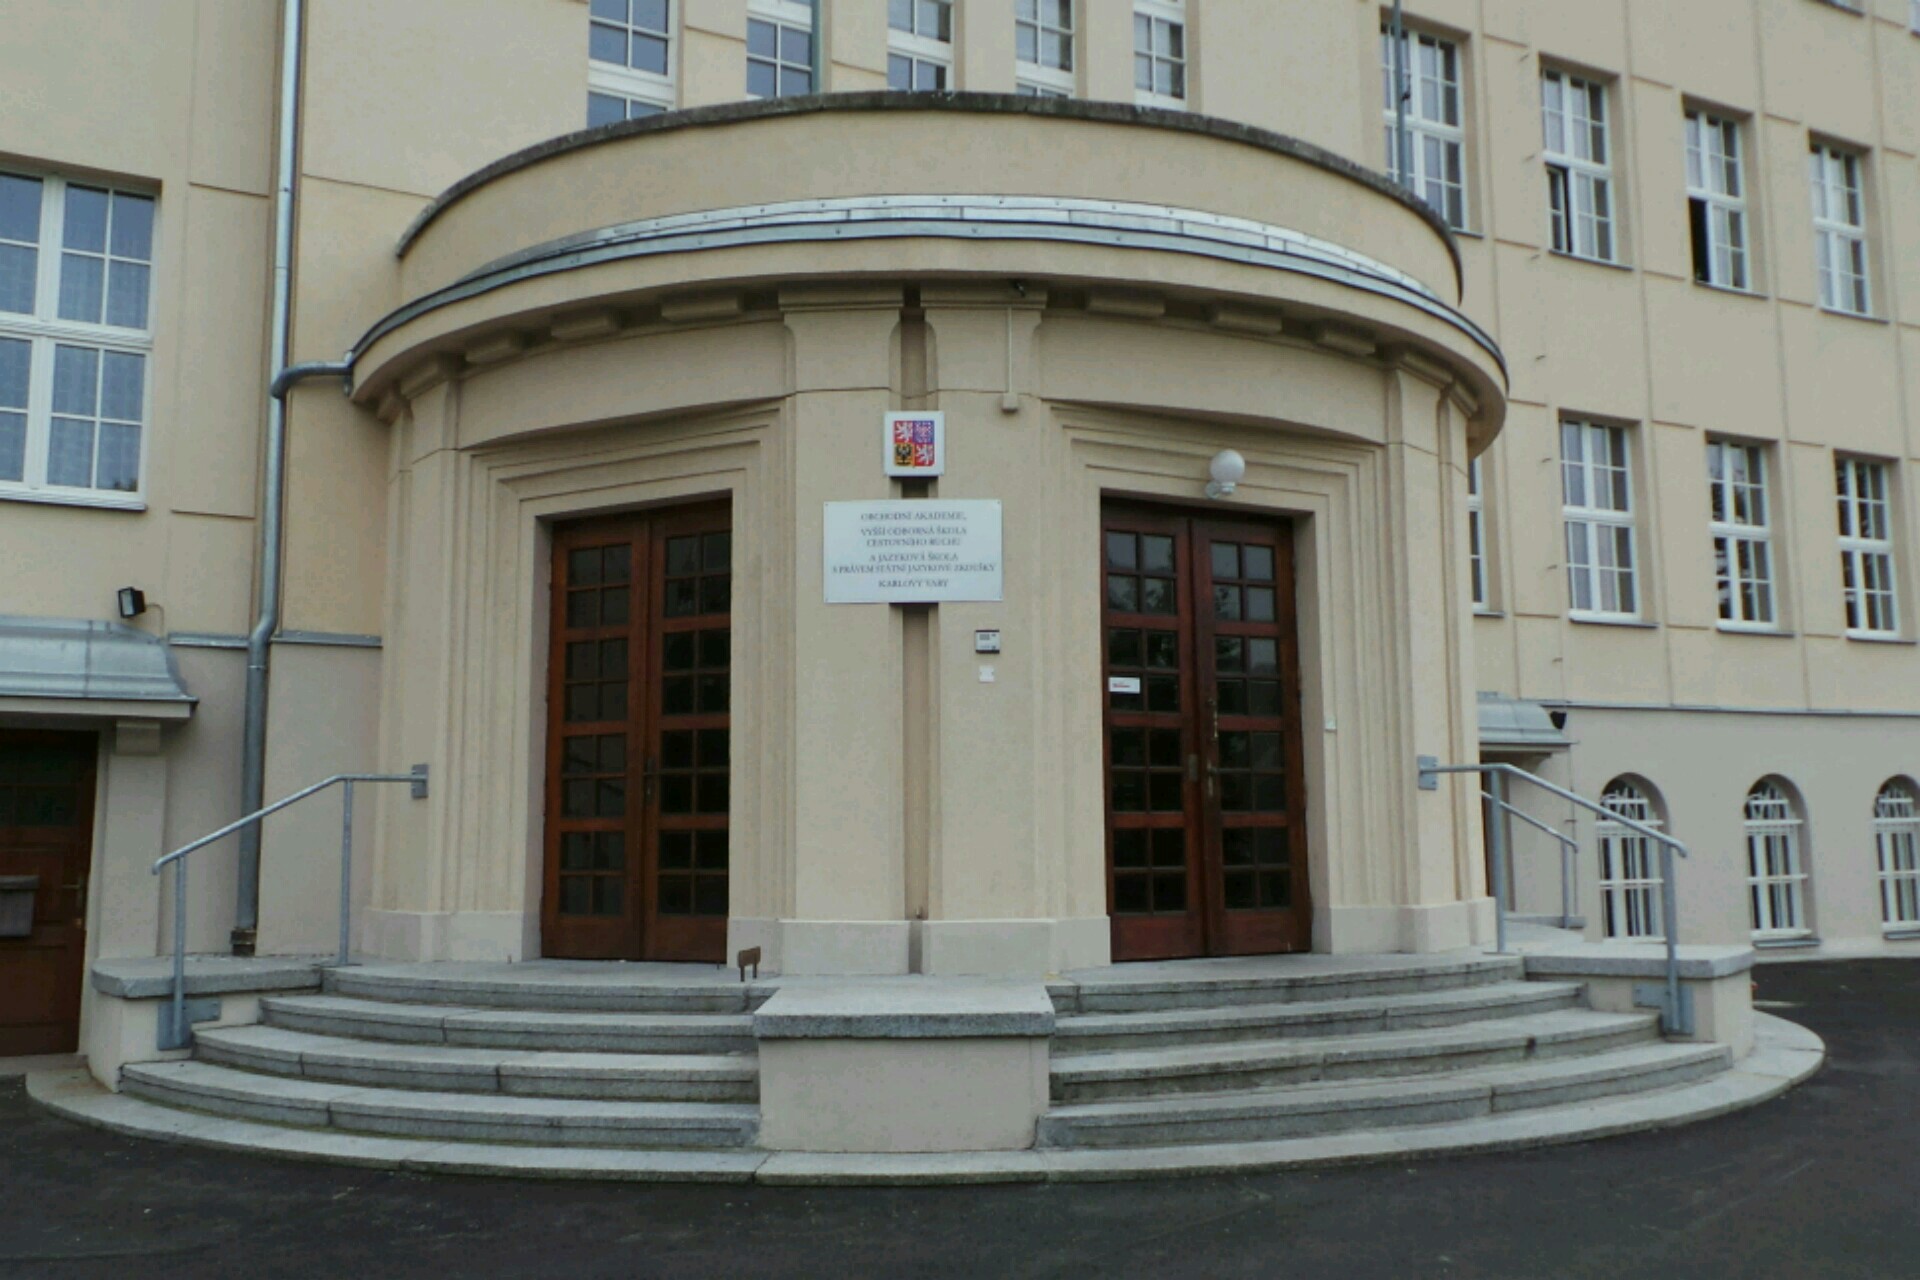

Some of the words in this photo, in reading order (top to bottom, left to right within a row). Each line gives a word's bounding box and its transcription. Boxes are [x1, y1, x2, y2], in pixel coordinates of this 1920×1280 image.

[860, 511, 912, 521] OBCHODNÍ
[914, 511, 967, 521] AKADEMIE,
[887, 524, 935, 535] ODBORNÁ
[936, 524, 967, 535] ŠKOLA
[878, 552, 925, 562] JAZYKOVÁ
[928, 551, 959, 562] ŠKOLA
[878, 579, 922, 588] KARLOVY
[925, 579, 949, 588] VARY
